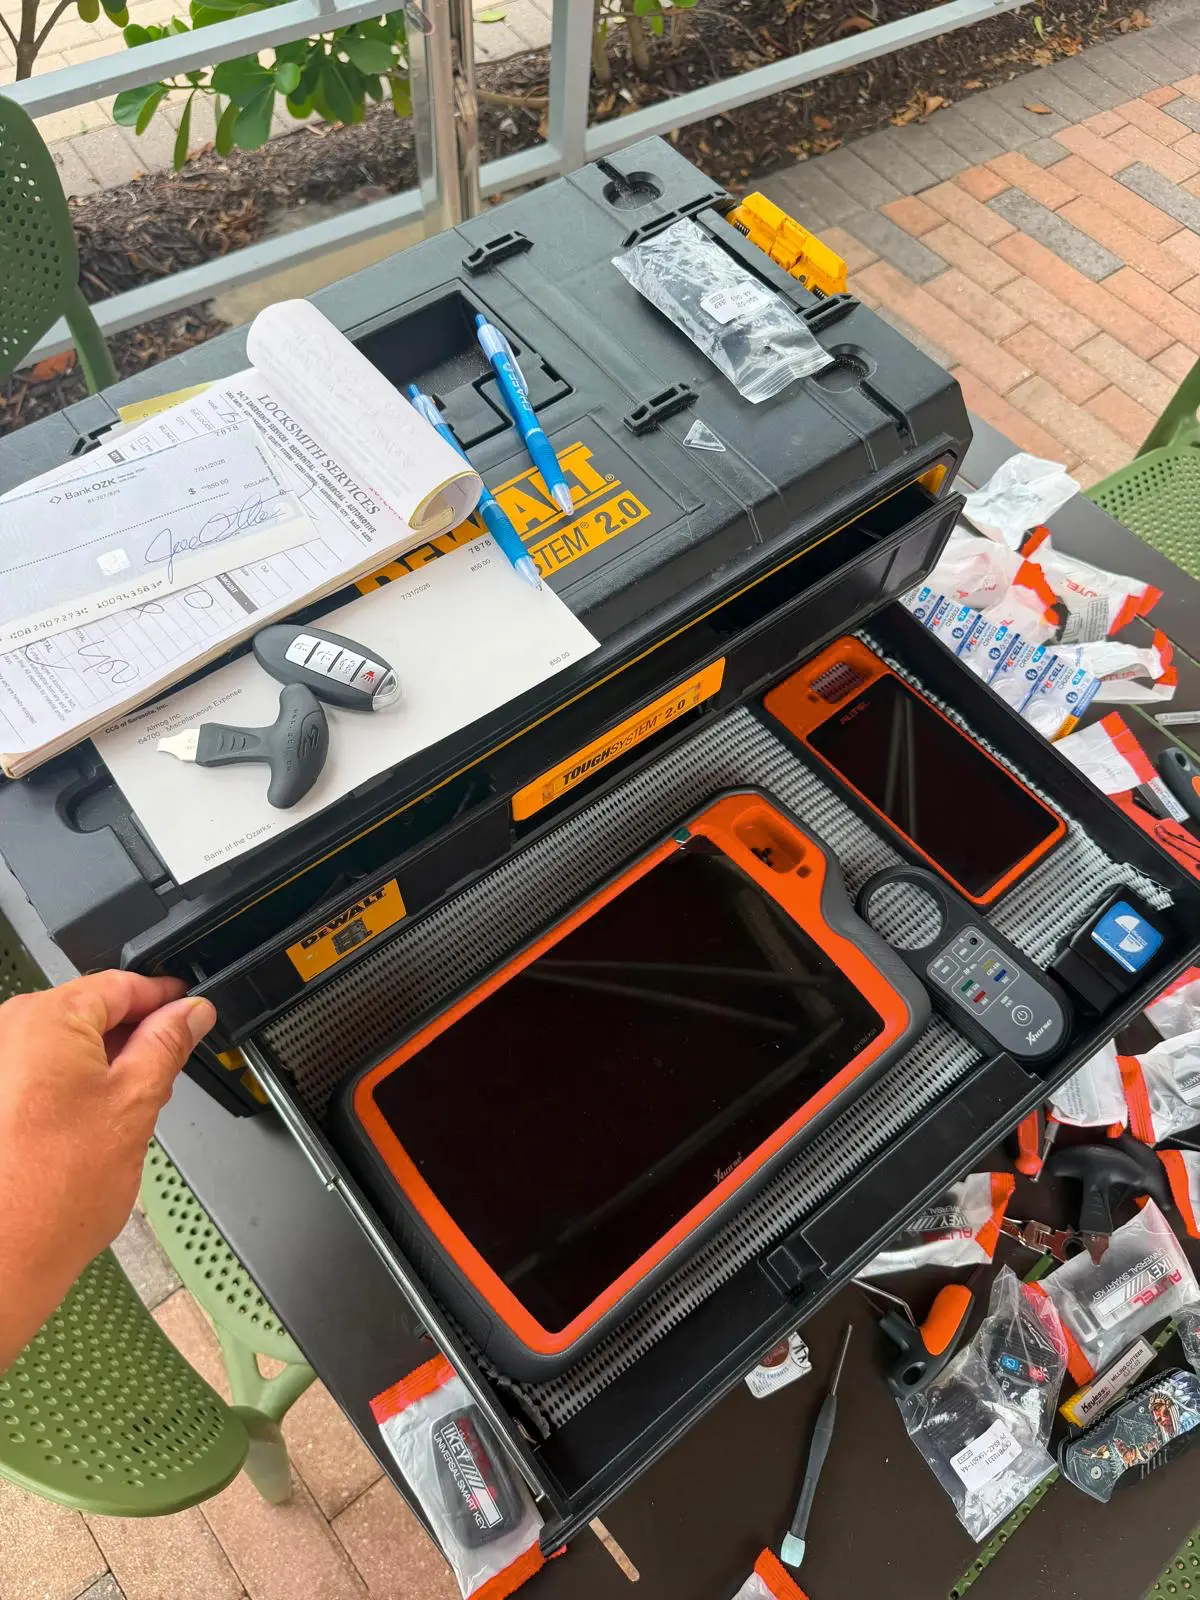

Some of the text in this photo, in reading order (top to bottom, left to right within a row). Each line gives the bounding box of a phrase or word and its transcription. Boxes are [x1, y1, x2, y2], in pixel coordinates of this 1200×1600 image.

[247, 400, 272, 426] EMERGENCY
[268, 423, 288, 443] SERVICES
[289, 444, 316, 471] RESIDENTIAL
[316, 471, 346, 501] COMMERCIAL
[347, 501, 377, 534] AUTOMOTIVE
[258, 394, 326, 460] LOCKSMITH
[321, 455, 380, 515] SERVICES
[188, 487, 197, 496] $
[243, 476, 270, 490] DOLLARS
[594, 497, 642, 536] 2.0
[468, 539, 493, 555] 7878
[401, 582, 431, 601] 7/31/2026
[964, 619, 987, 652] PKCELL
[1001, 638, 1025, 673] PKCELL
[165, 705, 214, 732] Miscellaneous
[212, 688, 243, 707] Expense
[664, 699, 686, 720] 2.0
[203, 849, 224, 862] Bank
[233, 838, 246, 848] the
[245, 823, 273, 840] Ozarks
[940, 1214, 968, 1227] IKEY
[1090, 1246, 1167, 1300] UNIVERSAL SMART KEY
[1142, 1257, 1173, 1281] IKEY
[1131, 1270, 1184, 1308] AUTEL
[1110, 1365, 1127, 1381] MILLING
[444, 1427, 470, 1461] IKEY
[433, 1432, 460, 1477] UNIVERSAL
[456, 1479, 478, 1511] SMART
[472, 1511, 488, 1530] KEY
